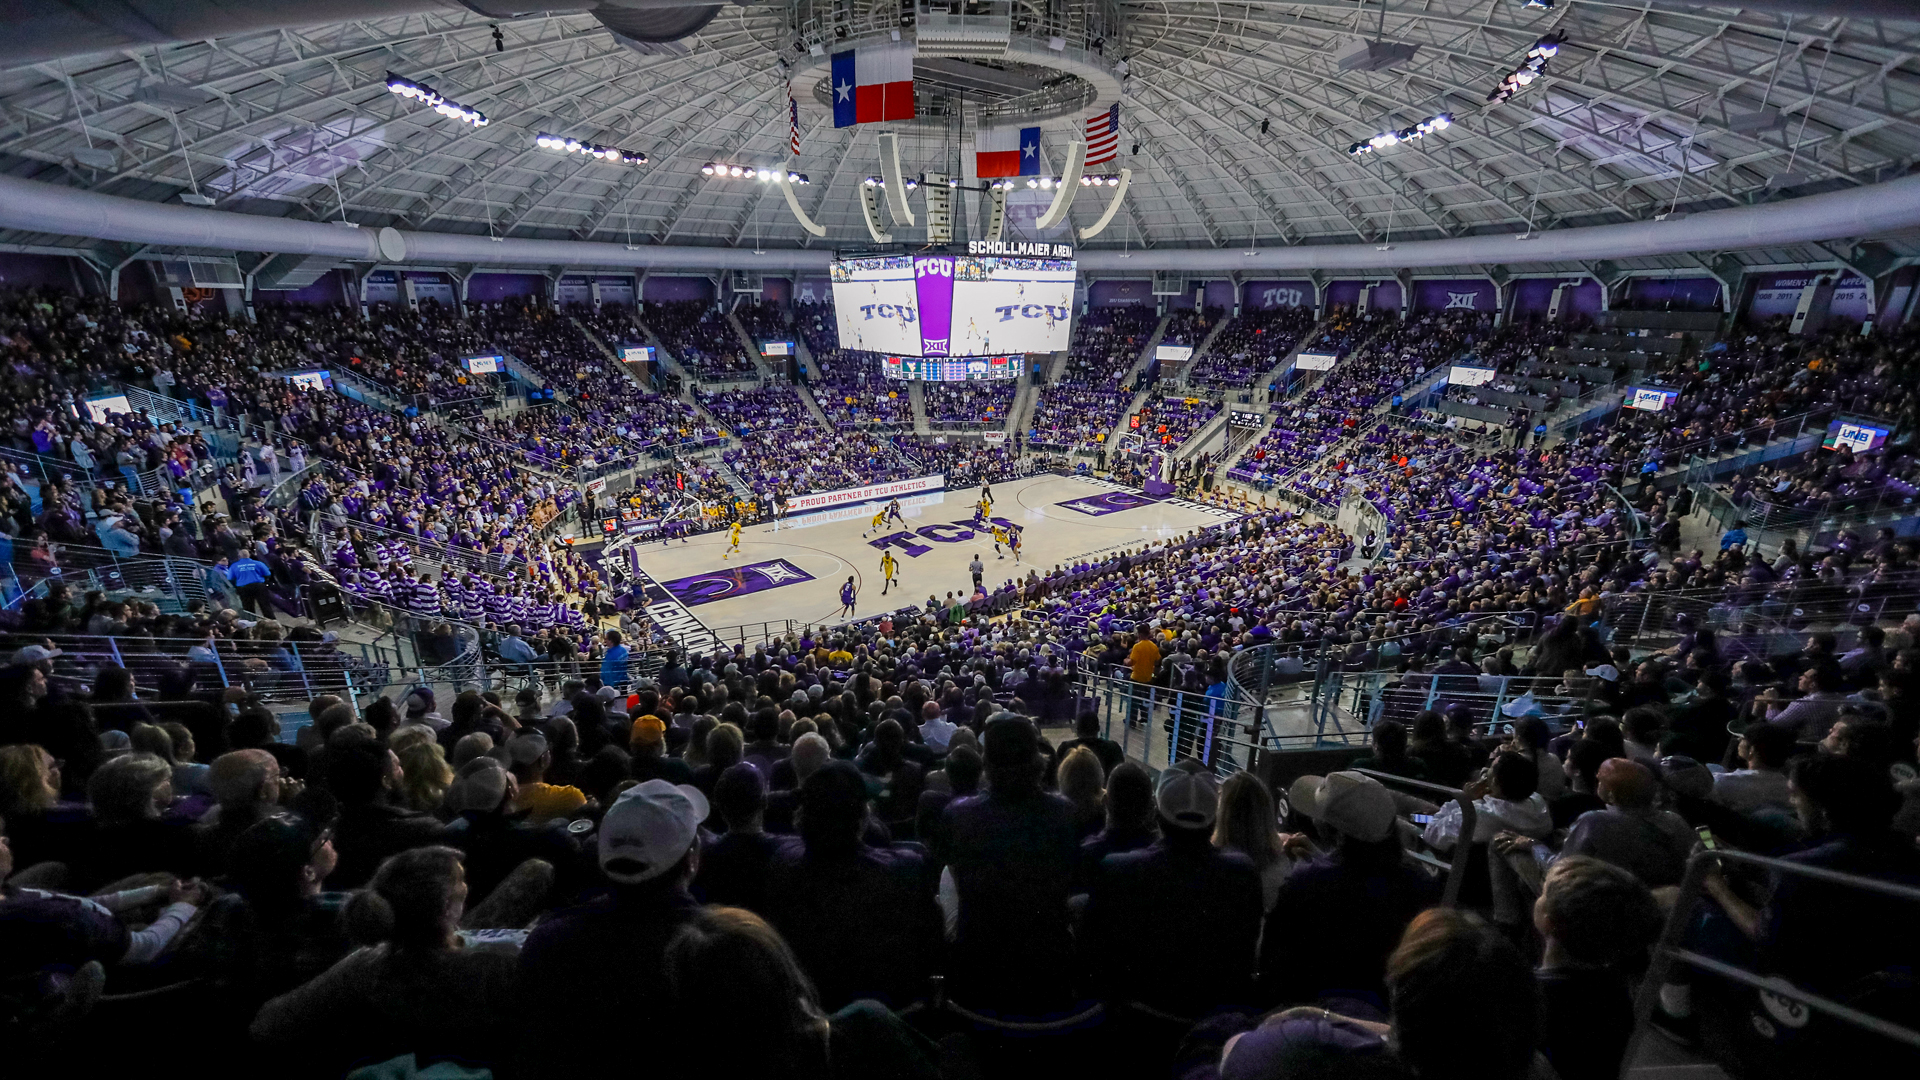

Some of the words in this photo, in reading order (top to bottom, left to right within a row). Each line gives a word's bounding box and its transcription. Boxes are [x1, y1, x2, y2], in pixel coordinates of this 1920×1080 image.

[968, 240, 1050, 256] SCHOLLMAIER
[1052, 244, 1073, 258] ARENA
[915, 258, 952, 278] TCU
[1775, 279, 1807, 287] WOMEN'S
[1263, 287, 1303, 308] TCU
[1445, 291, 1478, 310] XII
[860, 304, 917, 323] TCU
[995, 304, 1070, 322] TCU
[968, 361, 987, 373] TCU
[1842, 428, 1869, 442] UMB
[801, 496, 826, 507] PROUD
[828, 491, 862, 503] PARTNER
[864, 488, 872, 497] OF
[874, 485, 889, 496] TCU
[890, 480, 926, 493] ATHLETICS
[1069, 476, 1145, 494] HORNED
[1162, 497, 1244, 519] FROGS
[867, 517, 1024, 558] TCU
